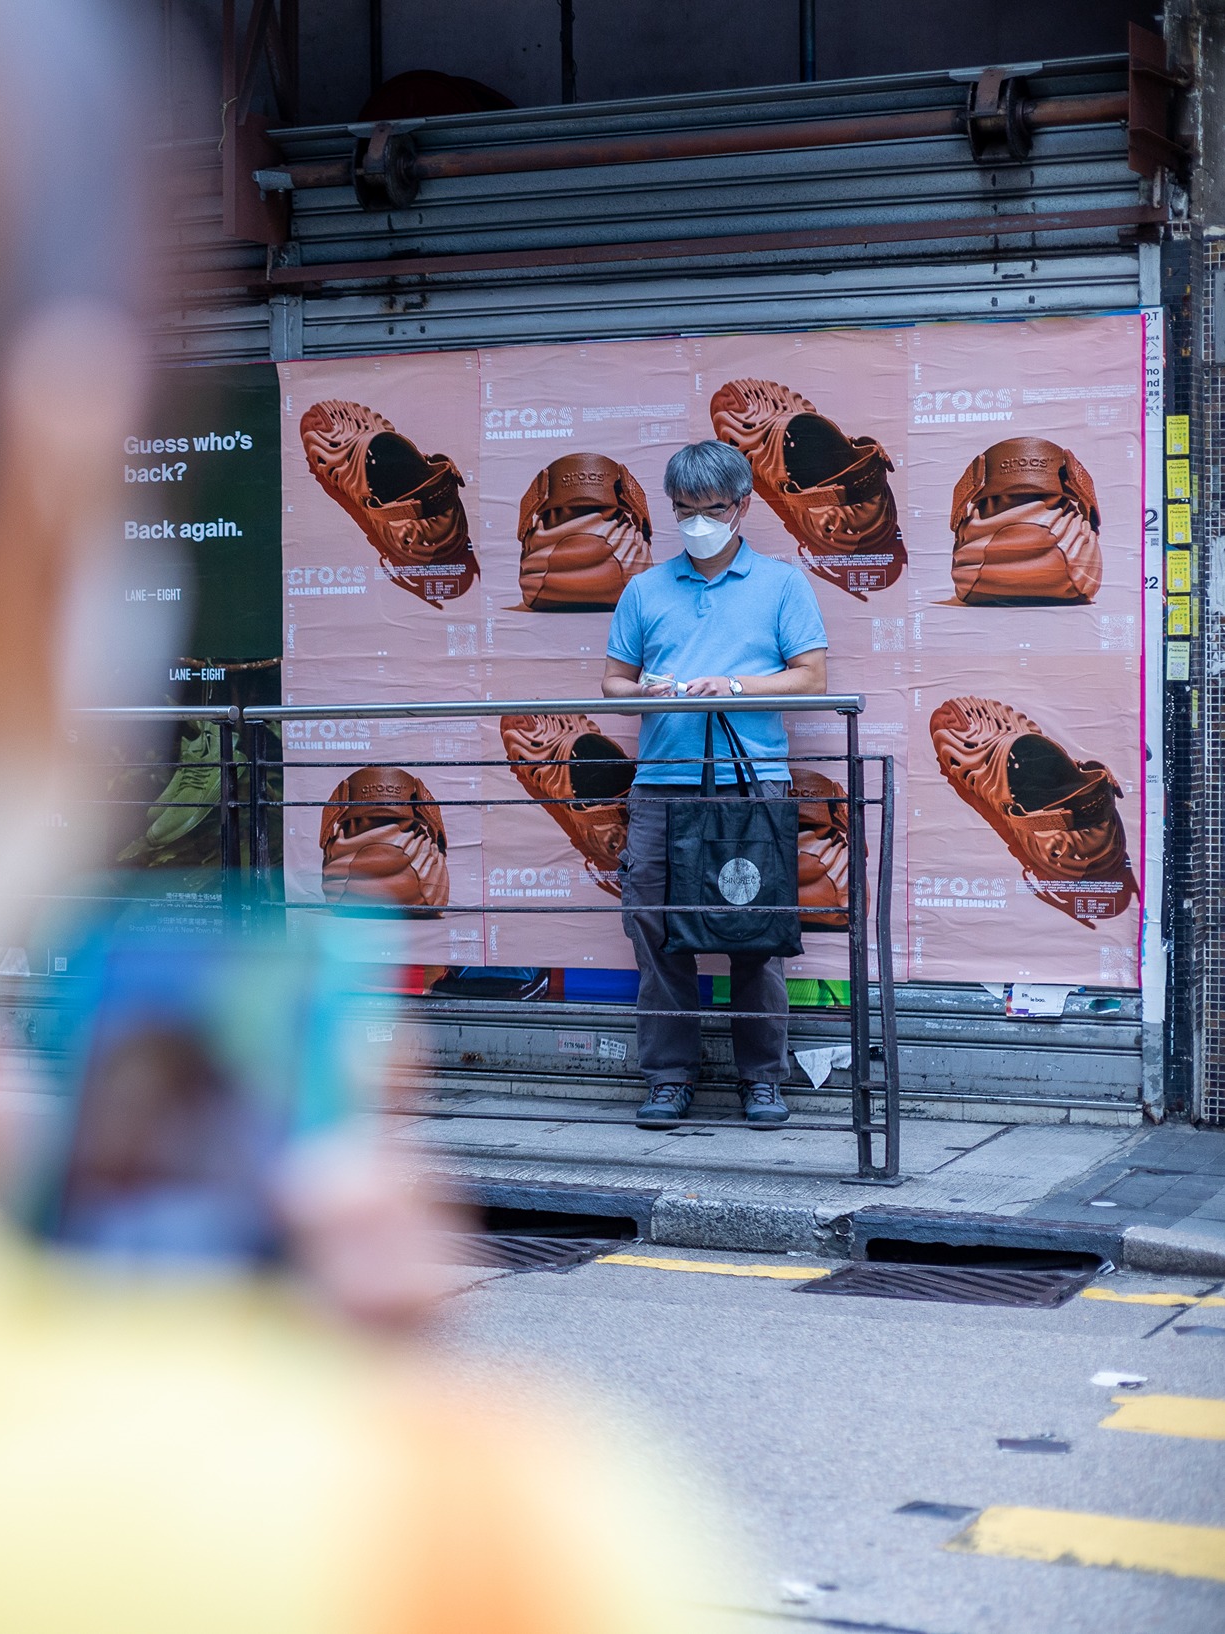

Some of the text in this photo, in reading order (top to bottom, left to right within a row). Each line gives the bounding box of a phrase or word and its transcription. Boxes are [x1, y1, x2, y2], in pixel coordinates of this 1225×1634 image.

[913, 388, 1013, 411] crocs
[485, 407, 574, 428] crocs
[914, 413, 956, 424] SALEHE
[124, 435, 189, 455] Guess
[485, 430, 523, 440] SALEHE
[125, 462, 187, 483] back?
[124, 518, 243, 542] Back again.
[287, 565, 367, 585] crocs
[288, 586, 322, 596] SALEHE
[286, 720, 371, 739] crocs
[287, 741, 324, 750] SALEHE
[488, 867, 572, 887] crocs
[914, 876, 1007, 897] crocs
[489, 888, 524, 897] SALEHE
[914, 898, 954, 907] SALEHE
